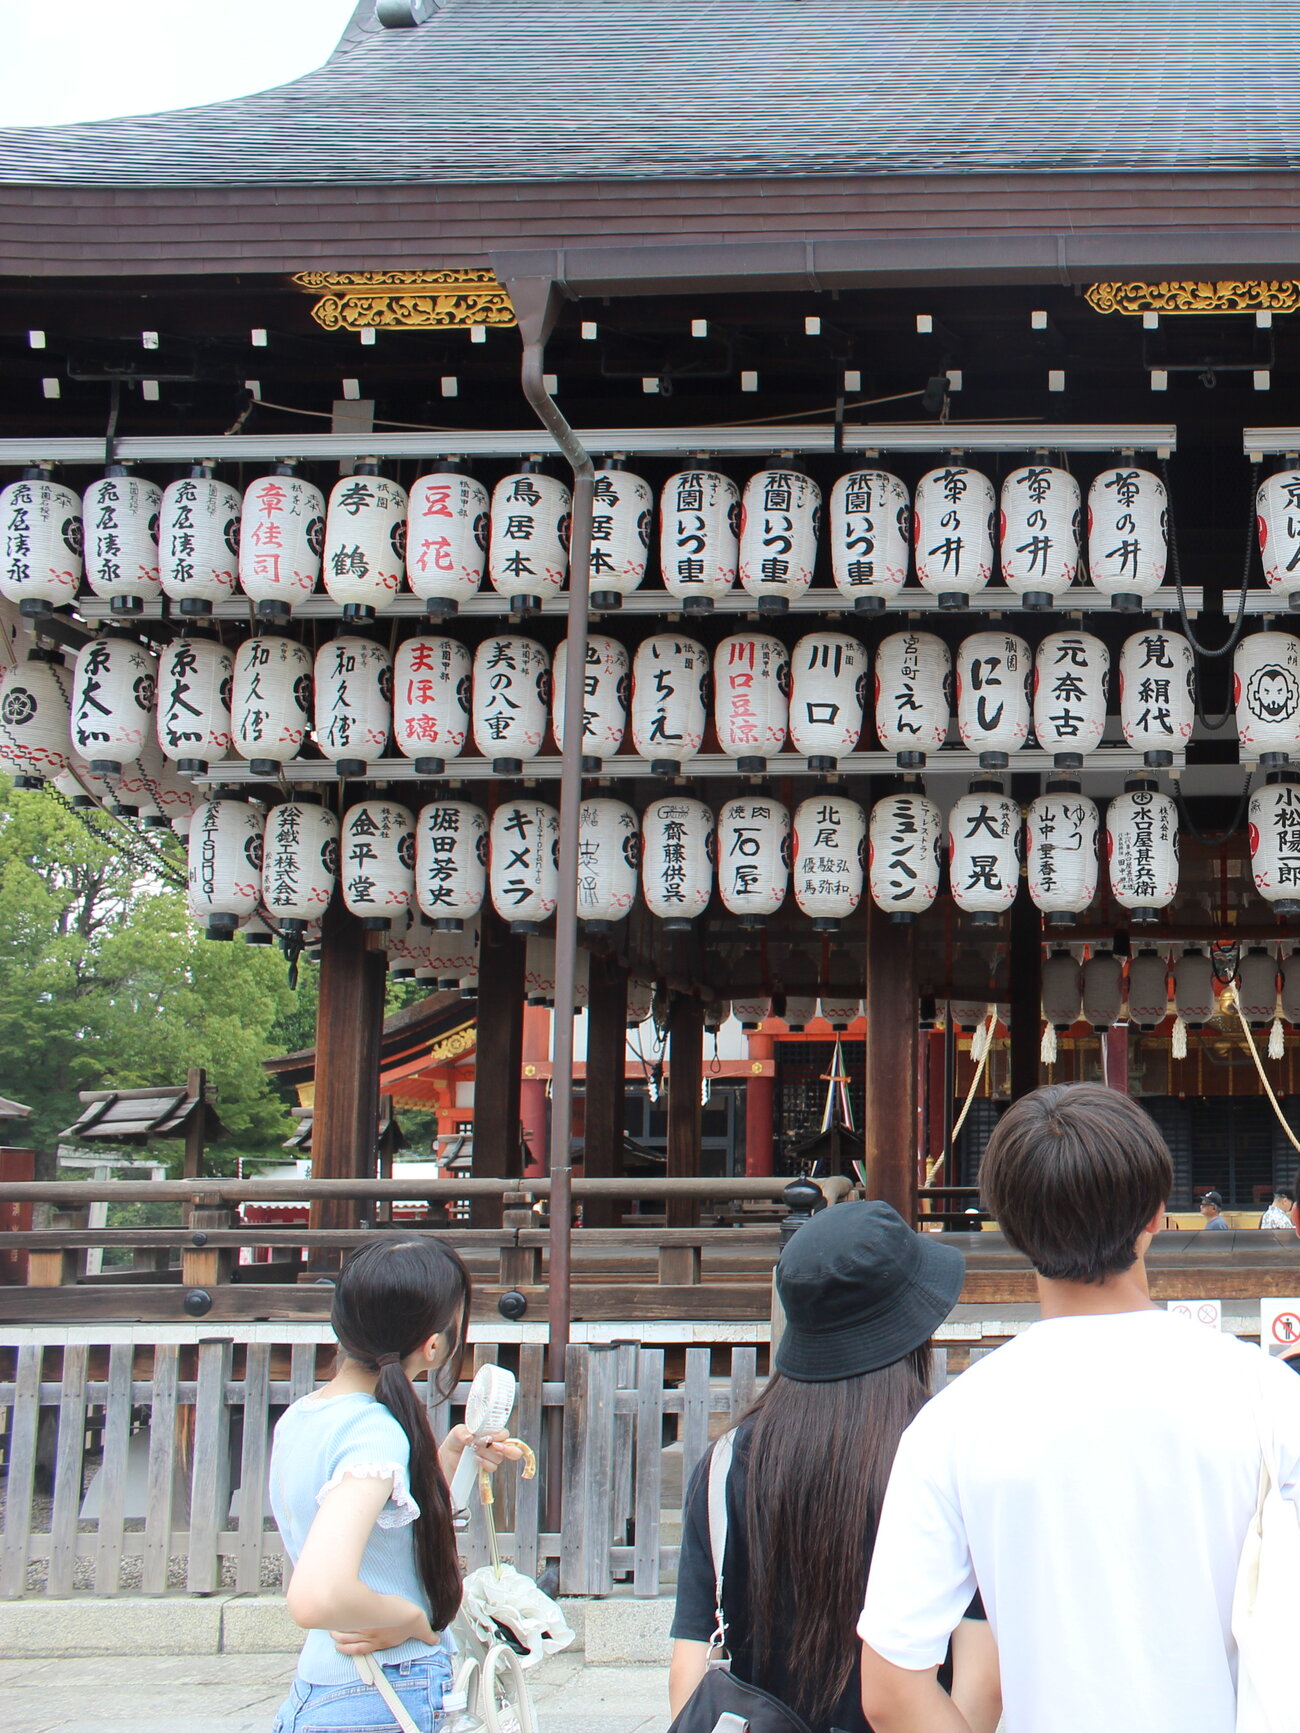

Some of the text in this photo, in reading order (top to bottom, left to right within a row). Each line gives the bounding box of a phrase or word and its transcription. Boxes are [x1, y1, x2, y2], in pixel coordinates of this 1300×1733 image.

[250, 483, 287, 583] 章佳司
[331, 482, 376, 580] 孝鶴
[376, 483, 389, 509] 祇園
[416, 485, 455, 571] 豆花
[457, 480, 471, 518] 祇園甲部
[503, 477, 542, 578] 鳥居本
[676, 473, 707, 584] 祇園いづ重
[762, 473, 794, 584] 祇園いづ重
[844, 474, 877, 586] 祇園いづ重
[929, 468, 969, 577] 菊乃井
[1016, 468, 1054, 577] 菊乃井
[1105, 472, 1142, 579] 菊乃井
[74, 641, 113, 747] 京大和
[165, 641, 203, 748] 京大和
[405, 643, 440, 744] まほ璃
[440, 642, 452, 682] 祇園甲部
[484, 641, 522, 741] 美の八重
[520, 641, 531, 676] 祇園甲部
[650, 641, 682, 743] いちえ
[683, 643, 695, 669] 祇園
[728, 641, 759, 744] 川口豆涼
[806, 644, 843, 725] 川口
[845, 644, 855, 665] 祇園
[902, 635, 921, 681] 宮川町
[971, 657, 1004, 732] にし
[1050, 639, 1089, 739] 元奈古
[1136, 635, 1174, 734] 筧絹代
[894, 683, 924, 736] えん
[272, 806, 299, 907] 松井鐵工株式会社
[349, 809, 379, 904] 金平堂
[379, 807, 390, 838] 株式会社
[428, 808, 460, 907] 堀田芳史
[502, 809, 534, 905] キメラ
[535, 807, 545, 885] Ristorante
[727, 806, 771, 820] 焼肉
[815, 805, 842, 848] 北尾
[888, 799, 918, 902] ミュンヘン
[919, 800, 930, 861] ビアレストラン
[964, 805, 1003, 892] 大晃
[1000, 801, 1011, 836] 株式会社
[1039, 806, 1057, 892] 山中里香子
[1130, 807, 1157, 896] 水口屋甚兵衛
[1158, 806, 1170, 841] 株式会社
[729, 827, 764, 896] 石屋
